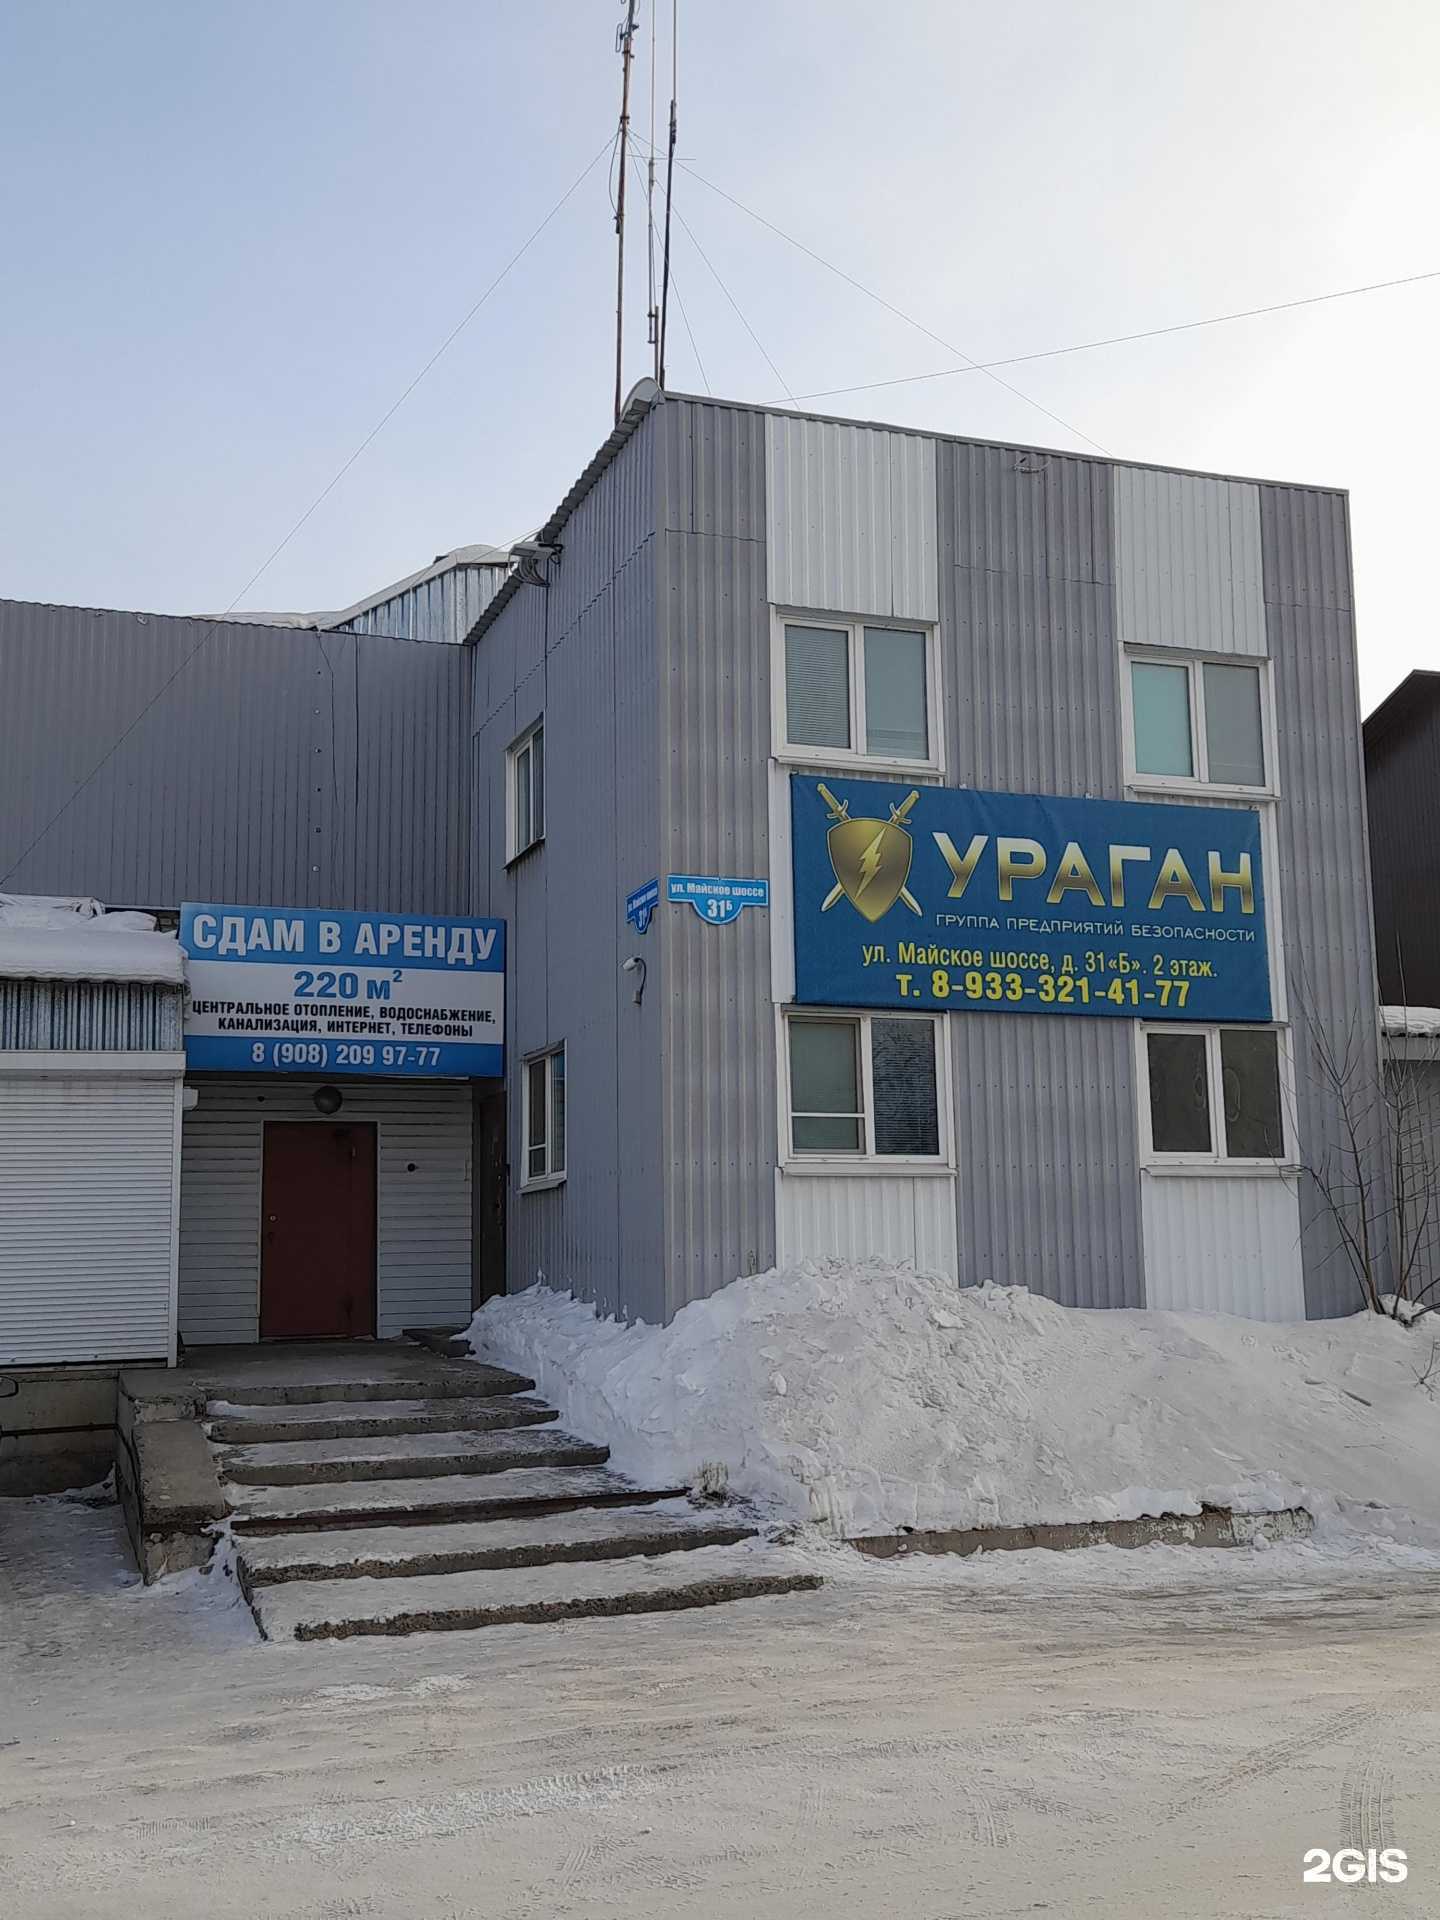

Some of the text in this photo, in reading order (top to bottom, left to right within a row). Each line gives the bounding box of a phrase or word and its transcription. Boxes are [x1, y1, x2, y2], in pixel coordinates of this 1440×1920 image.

[931, 831, 1256, 915] УРАГАН
[687, 882, 730, 895] Майское
[732, 886, 764, 897] шоссе
[193, 914, 497, 965] СДАМ В АРЕНДУ
[936, 914, 1256, 943] ГРУППА ПРЕДПРИЯТИЙ БЕЗОПАСНОСТИ
[862, 947, 890, 967] ул.
[898, 942, 983, 968] Майское
[989, 949, 1055, 972] шоссе,
[1061, 955, 1079, 976] д.
[1153, 954, 1164, 976] 2
[1169, 959, 1218, 978] этаж.
[294, 970, 359, 999] 220
[896, 970, 1190, 1008] т. 8-933-321-41-77
[192, 1000, 496, 1024] ЦЕНТРАЛЬНОЕ ОТОПЛЕНИЕ, ВОДОСНАБЖЕНИЕ,
[218, 1017, 473, 1037] КАНАЛИЗАЦИЯ, ИНТЕРНЕТ, ТЕЛЕФОНЫ
[252, 1042, 441, 1067] 8 (908) 209 97-77
